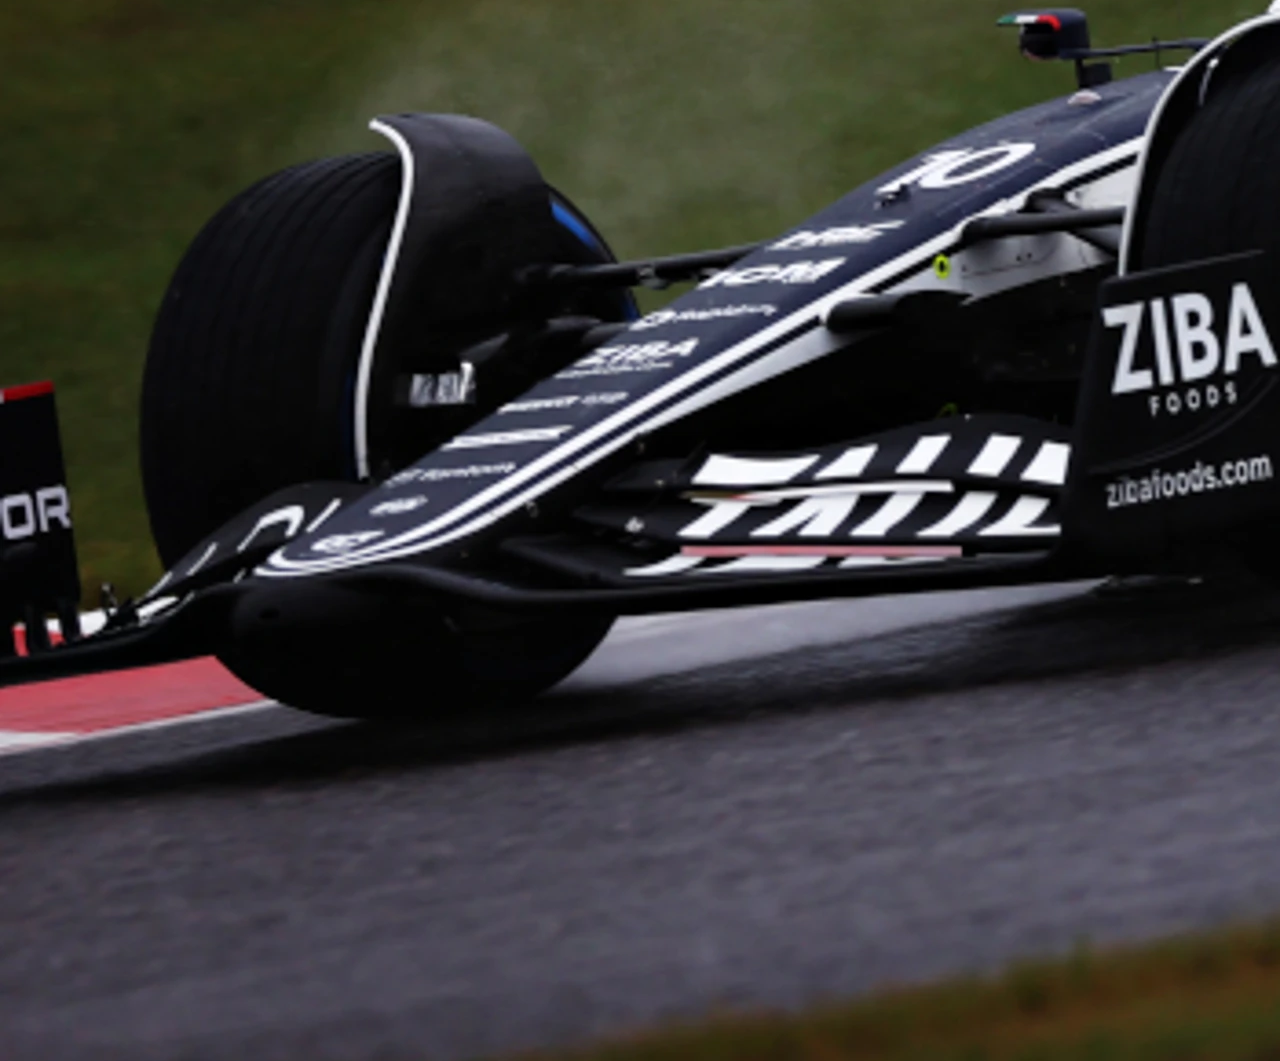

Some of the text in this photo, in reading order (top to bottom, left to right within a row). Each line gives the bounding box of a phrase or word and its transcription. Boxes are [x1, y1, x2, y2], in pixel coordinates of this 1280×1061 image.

[874, 141, 1037, 190] 10
[1101, 282, 1278, 395] ZIBA
[1148, 381, 1237, 417] FOODS
[1106, 454, 1273, 509] zibafoods.com
